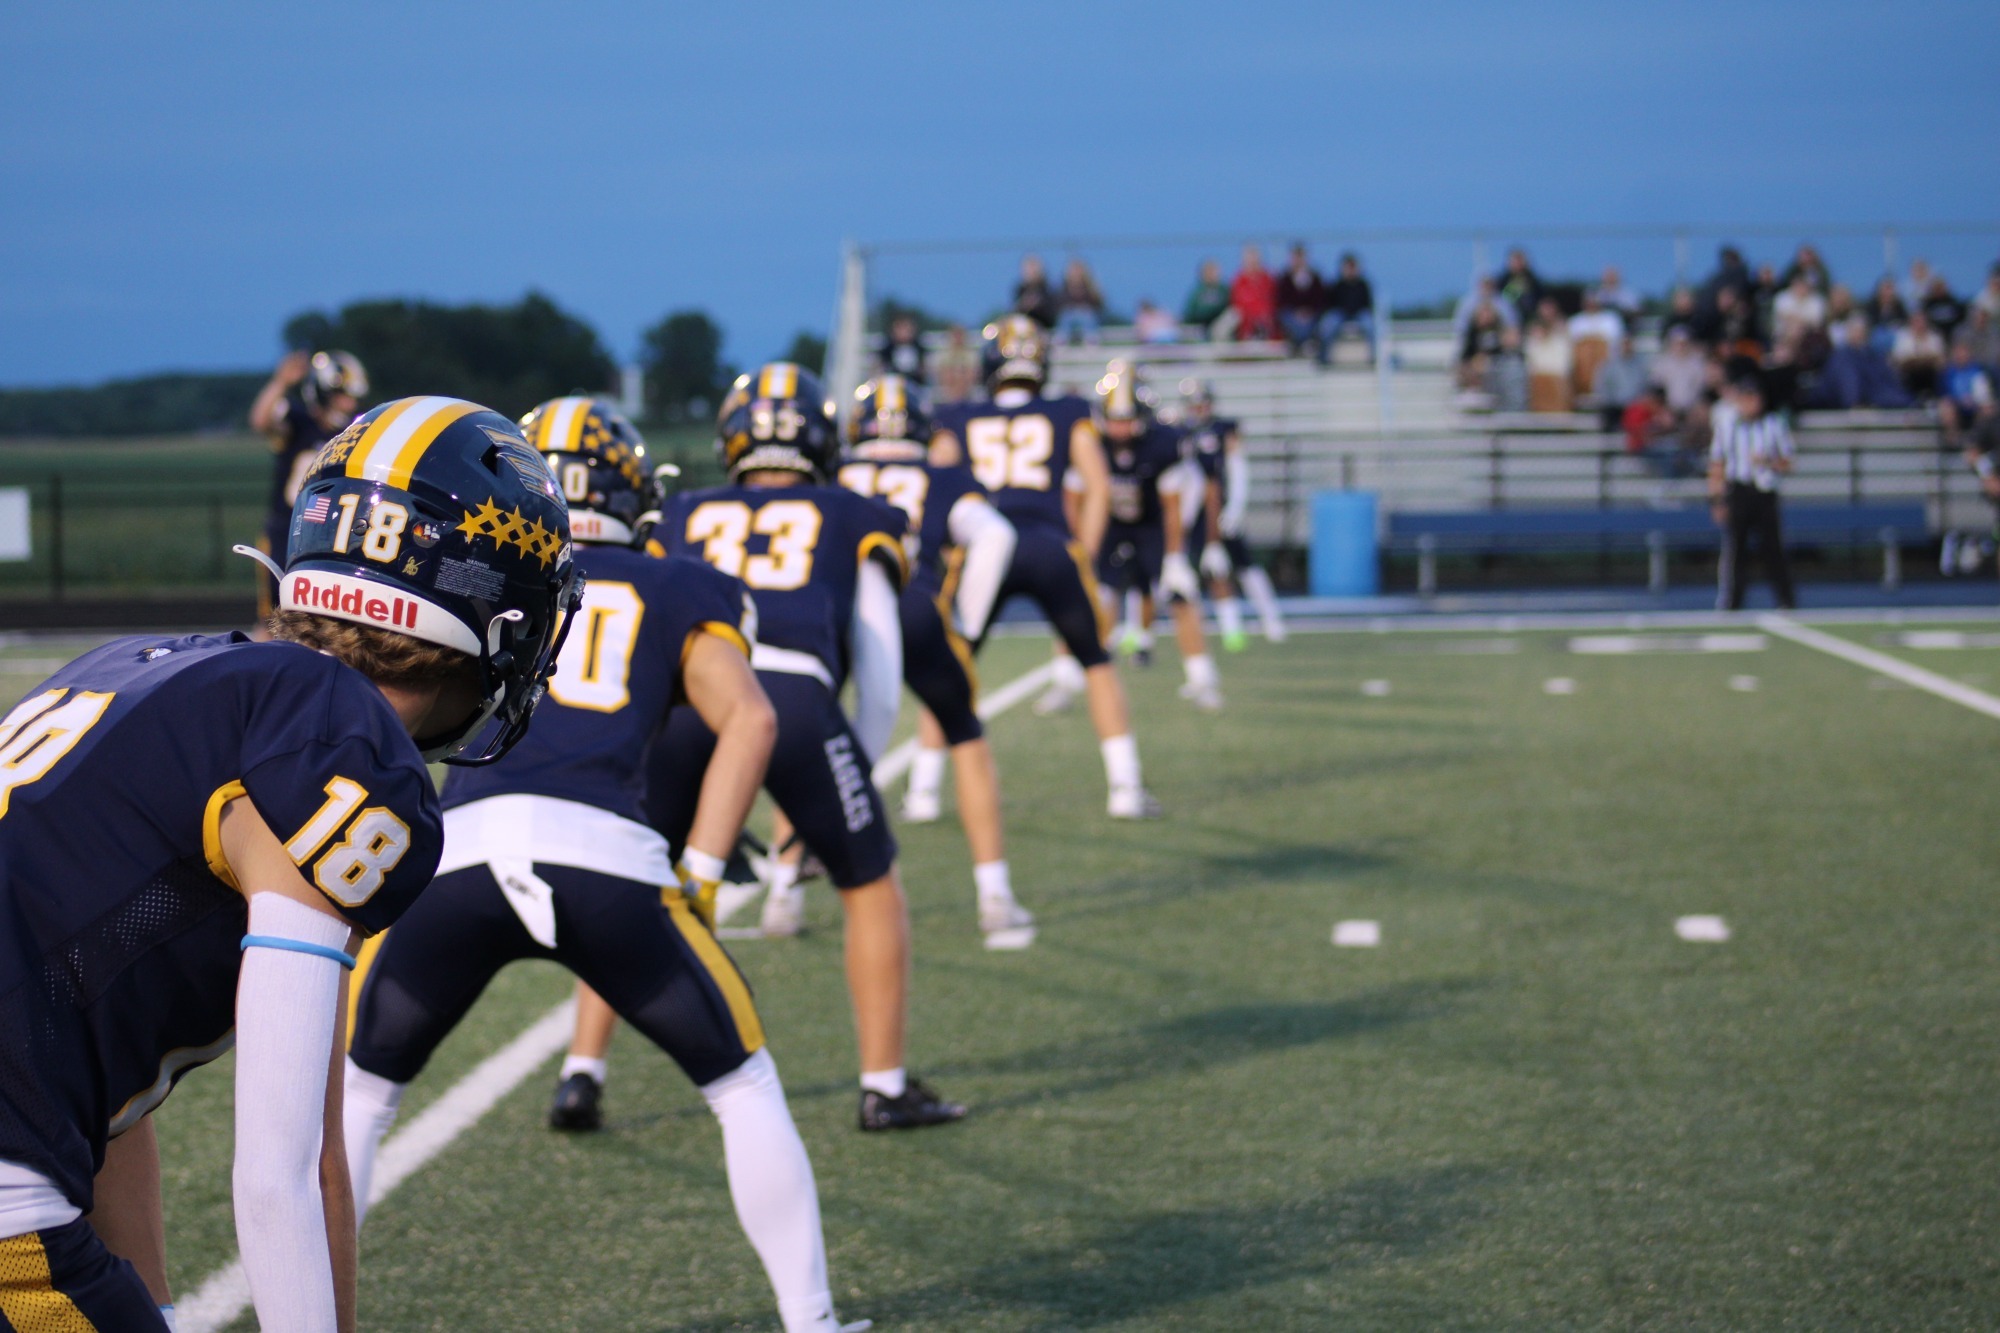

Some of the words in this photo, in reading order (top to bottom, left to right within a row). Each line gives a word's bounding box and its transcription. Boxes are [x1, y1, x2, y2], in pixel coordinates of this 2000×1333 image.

[966, 413, 1054, 492] 52
[333, 493, 409, 564] 18
[685, 499, 823, 591] 33
[293, 576, 418, 629] Riddell
[282, 774, 411, 908] 18
